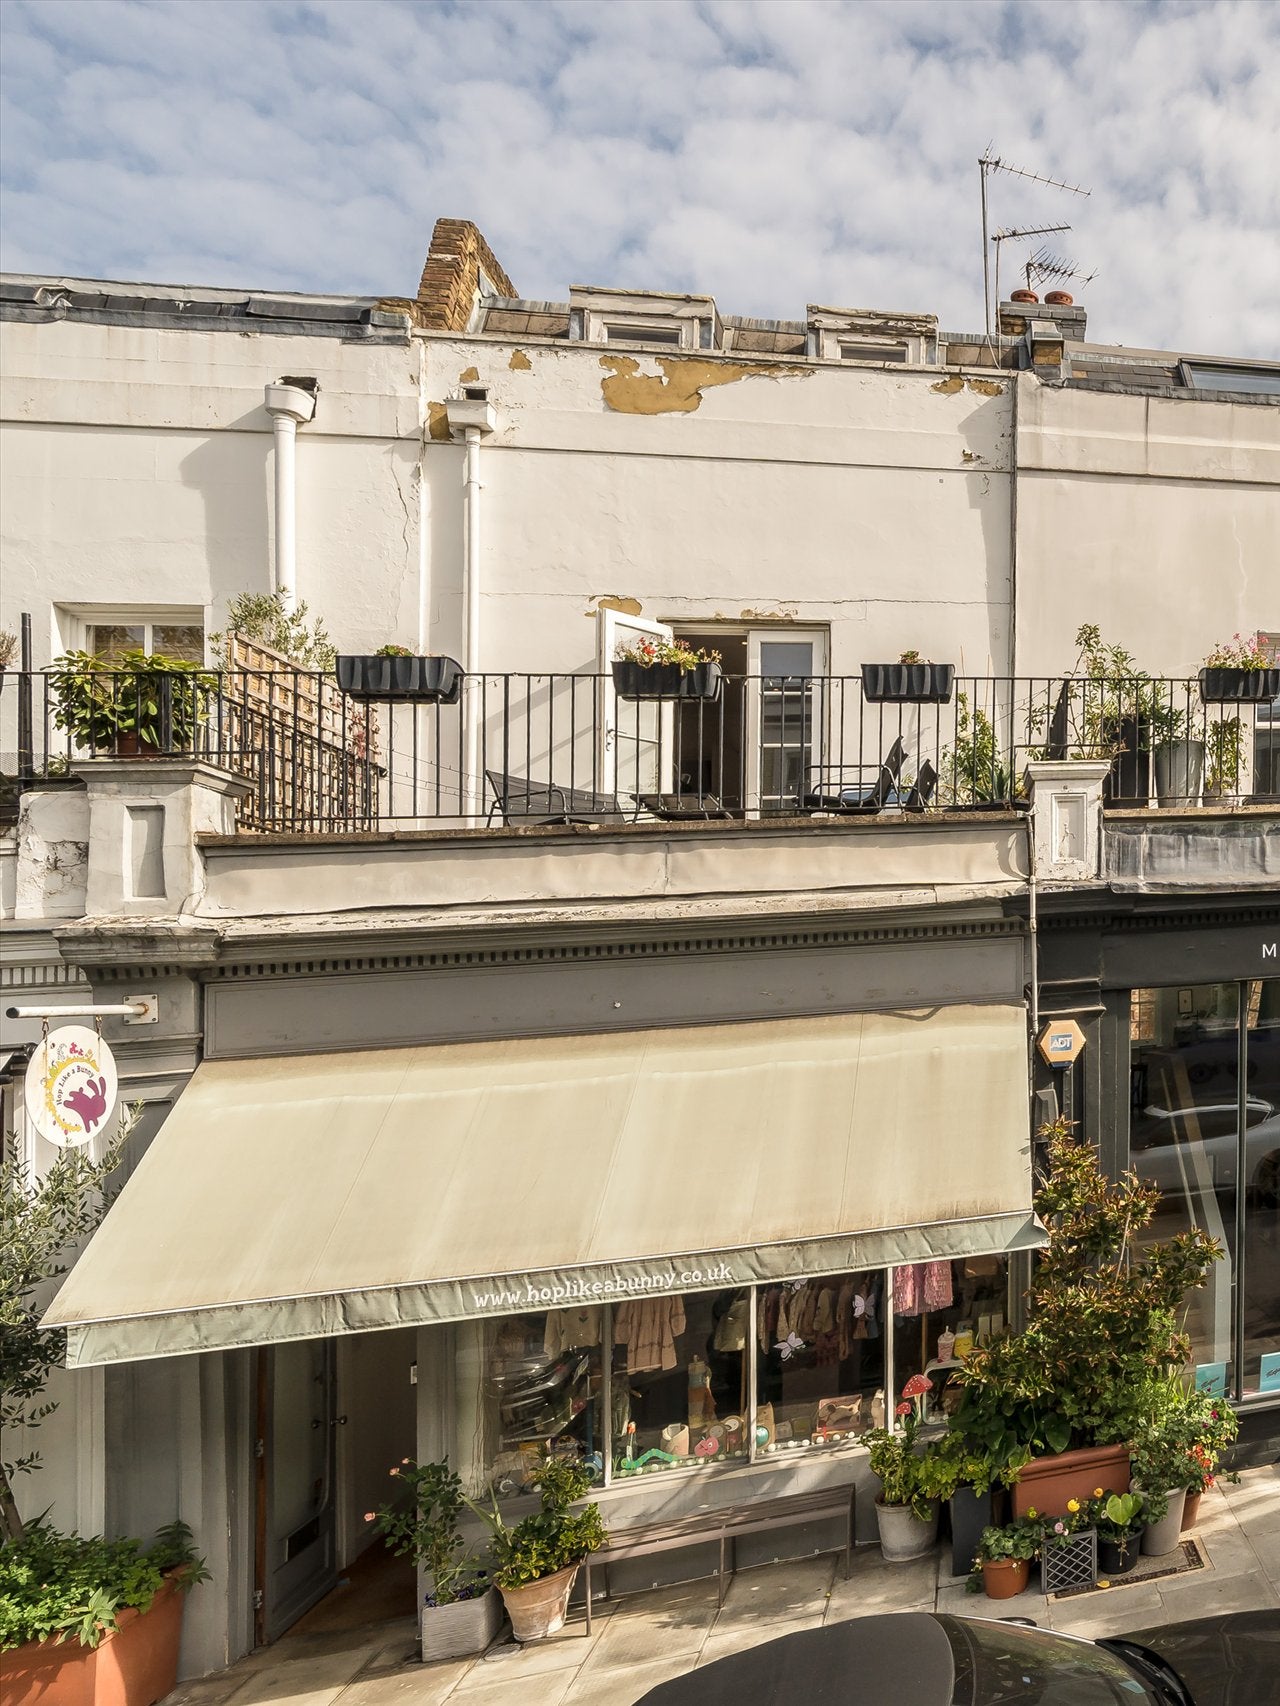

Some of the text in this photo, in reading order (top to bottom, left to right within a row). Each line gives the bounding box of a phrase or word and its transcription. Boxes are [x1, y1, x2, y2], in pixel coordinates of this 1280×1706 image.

[1051, 1037, 1072, 1048] ADT
[59, 1072, 71, 1087] Like
[77, 1065, 94, 1078] Bunny
[474, 1262, 732, 1308] www.hoplikeabunny.co.uk
